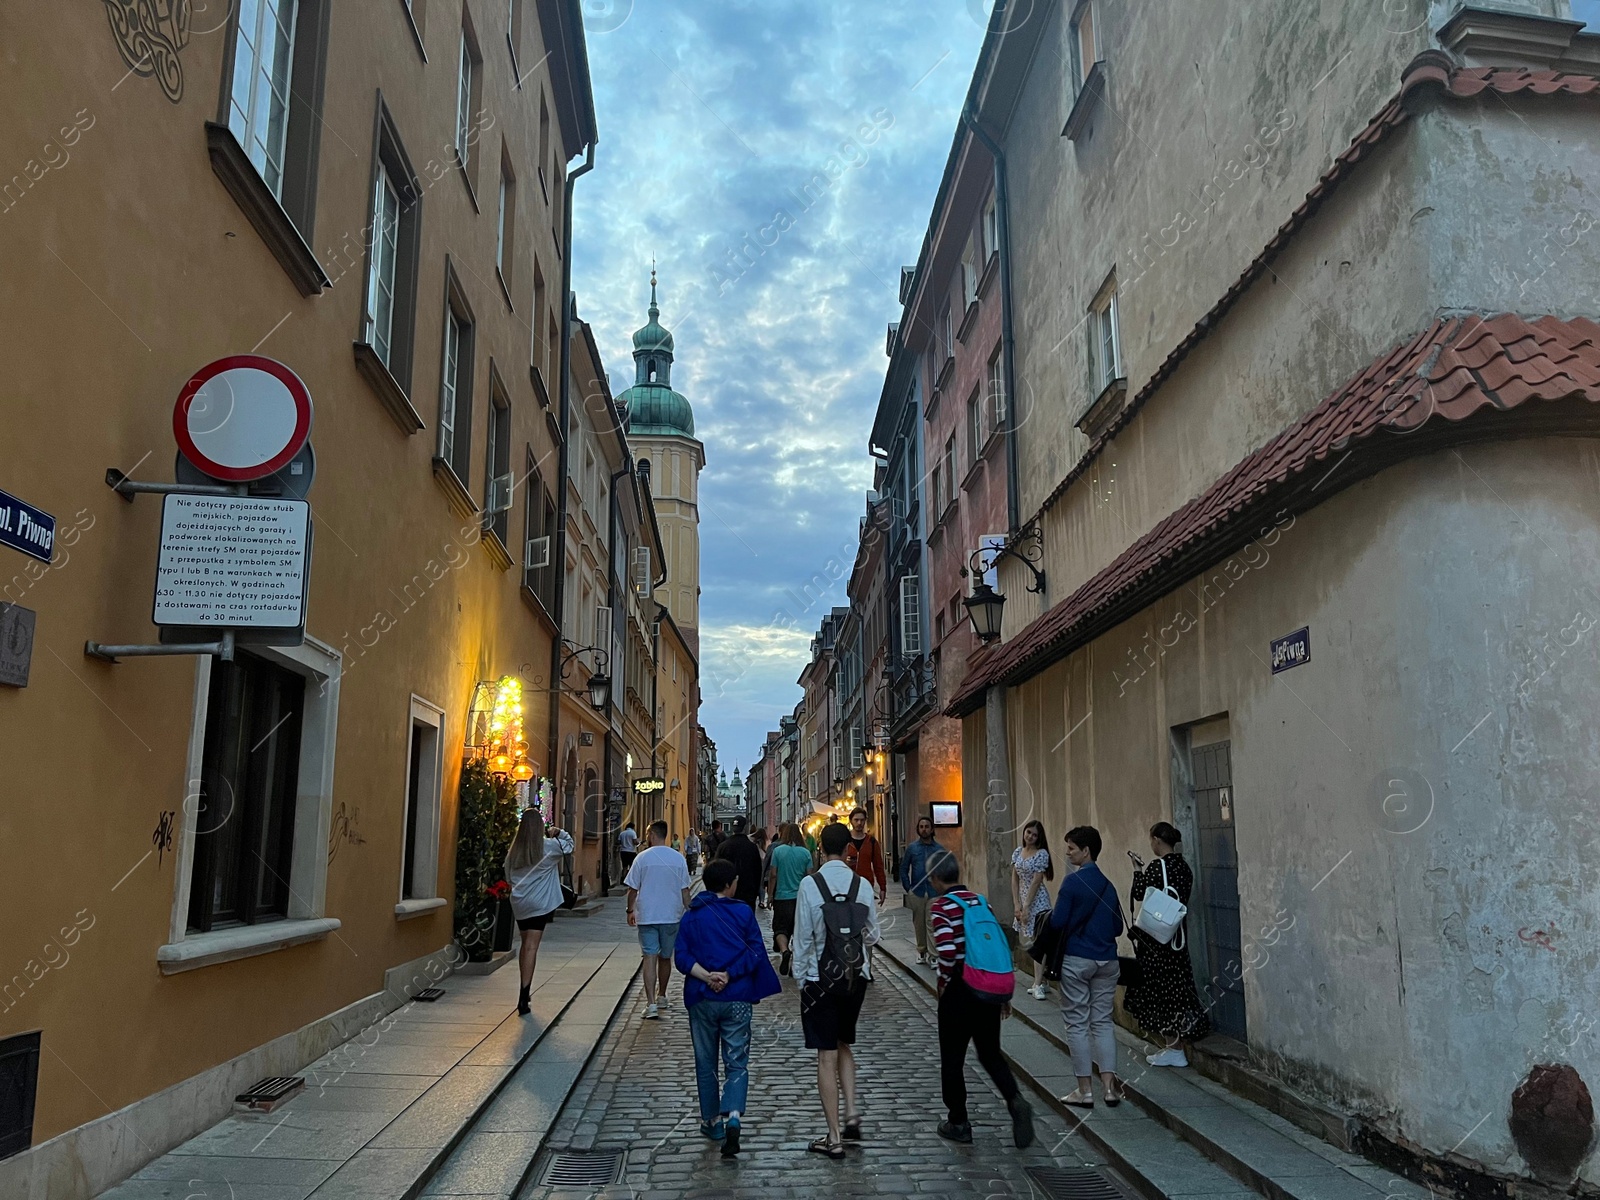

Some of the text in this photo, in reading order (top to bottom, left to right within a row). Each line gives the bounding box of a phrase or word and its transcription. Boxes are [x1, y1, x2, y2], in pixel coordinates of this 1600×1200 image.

[194, 500, 227, 510] dotyczy
[17, 509, 52, 550] Piwna
[244, 524, 255, 532] do
[214, 533, 282, 545] zlokalizowanych
[162, 543, 193, 551] terenie
[196, 545, 220, 554] strefy
[223, 545, 236, 553] SM
[234, 558, 276, 566] symbolem
[187, 566, 200, 574] lub
[284, 570, 300, 579] niej
[241, 580, 285, 589] godzinach
[184, 589, 206, 597] 11.30
[209, 590, 222, 598] nie
[225, 590, 258, 601] dotyczy
[163, 600, 211, 609] dostawami
[199, 612, 211, 621] do
[214, 613, 225, 621] 30
